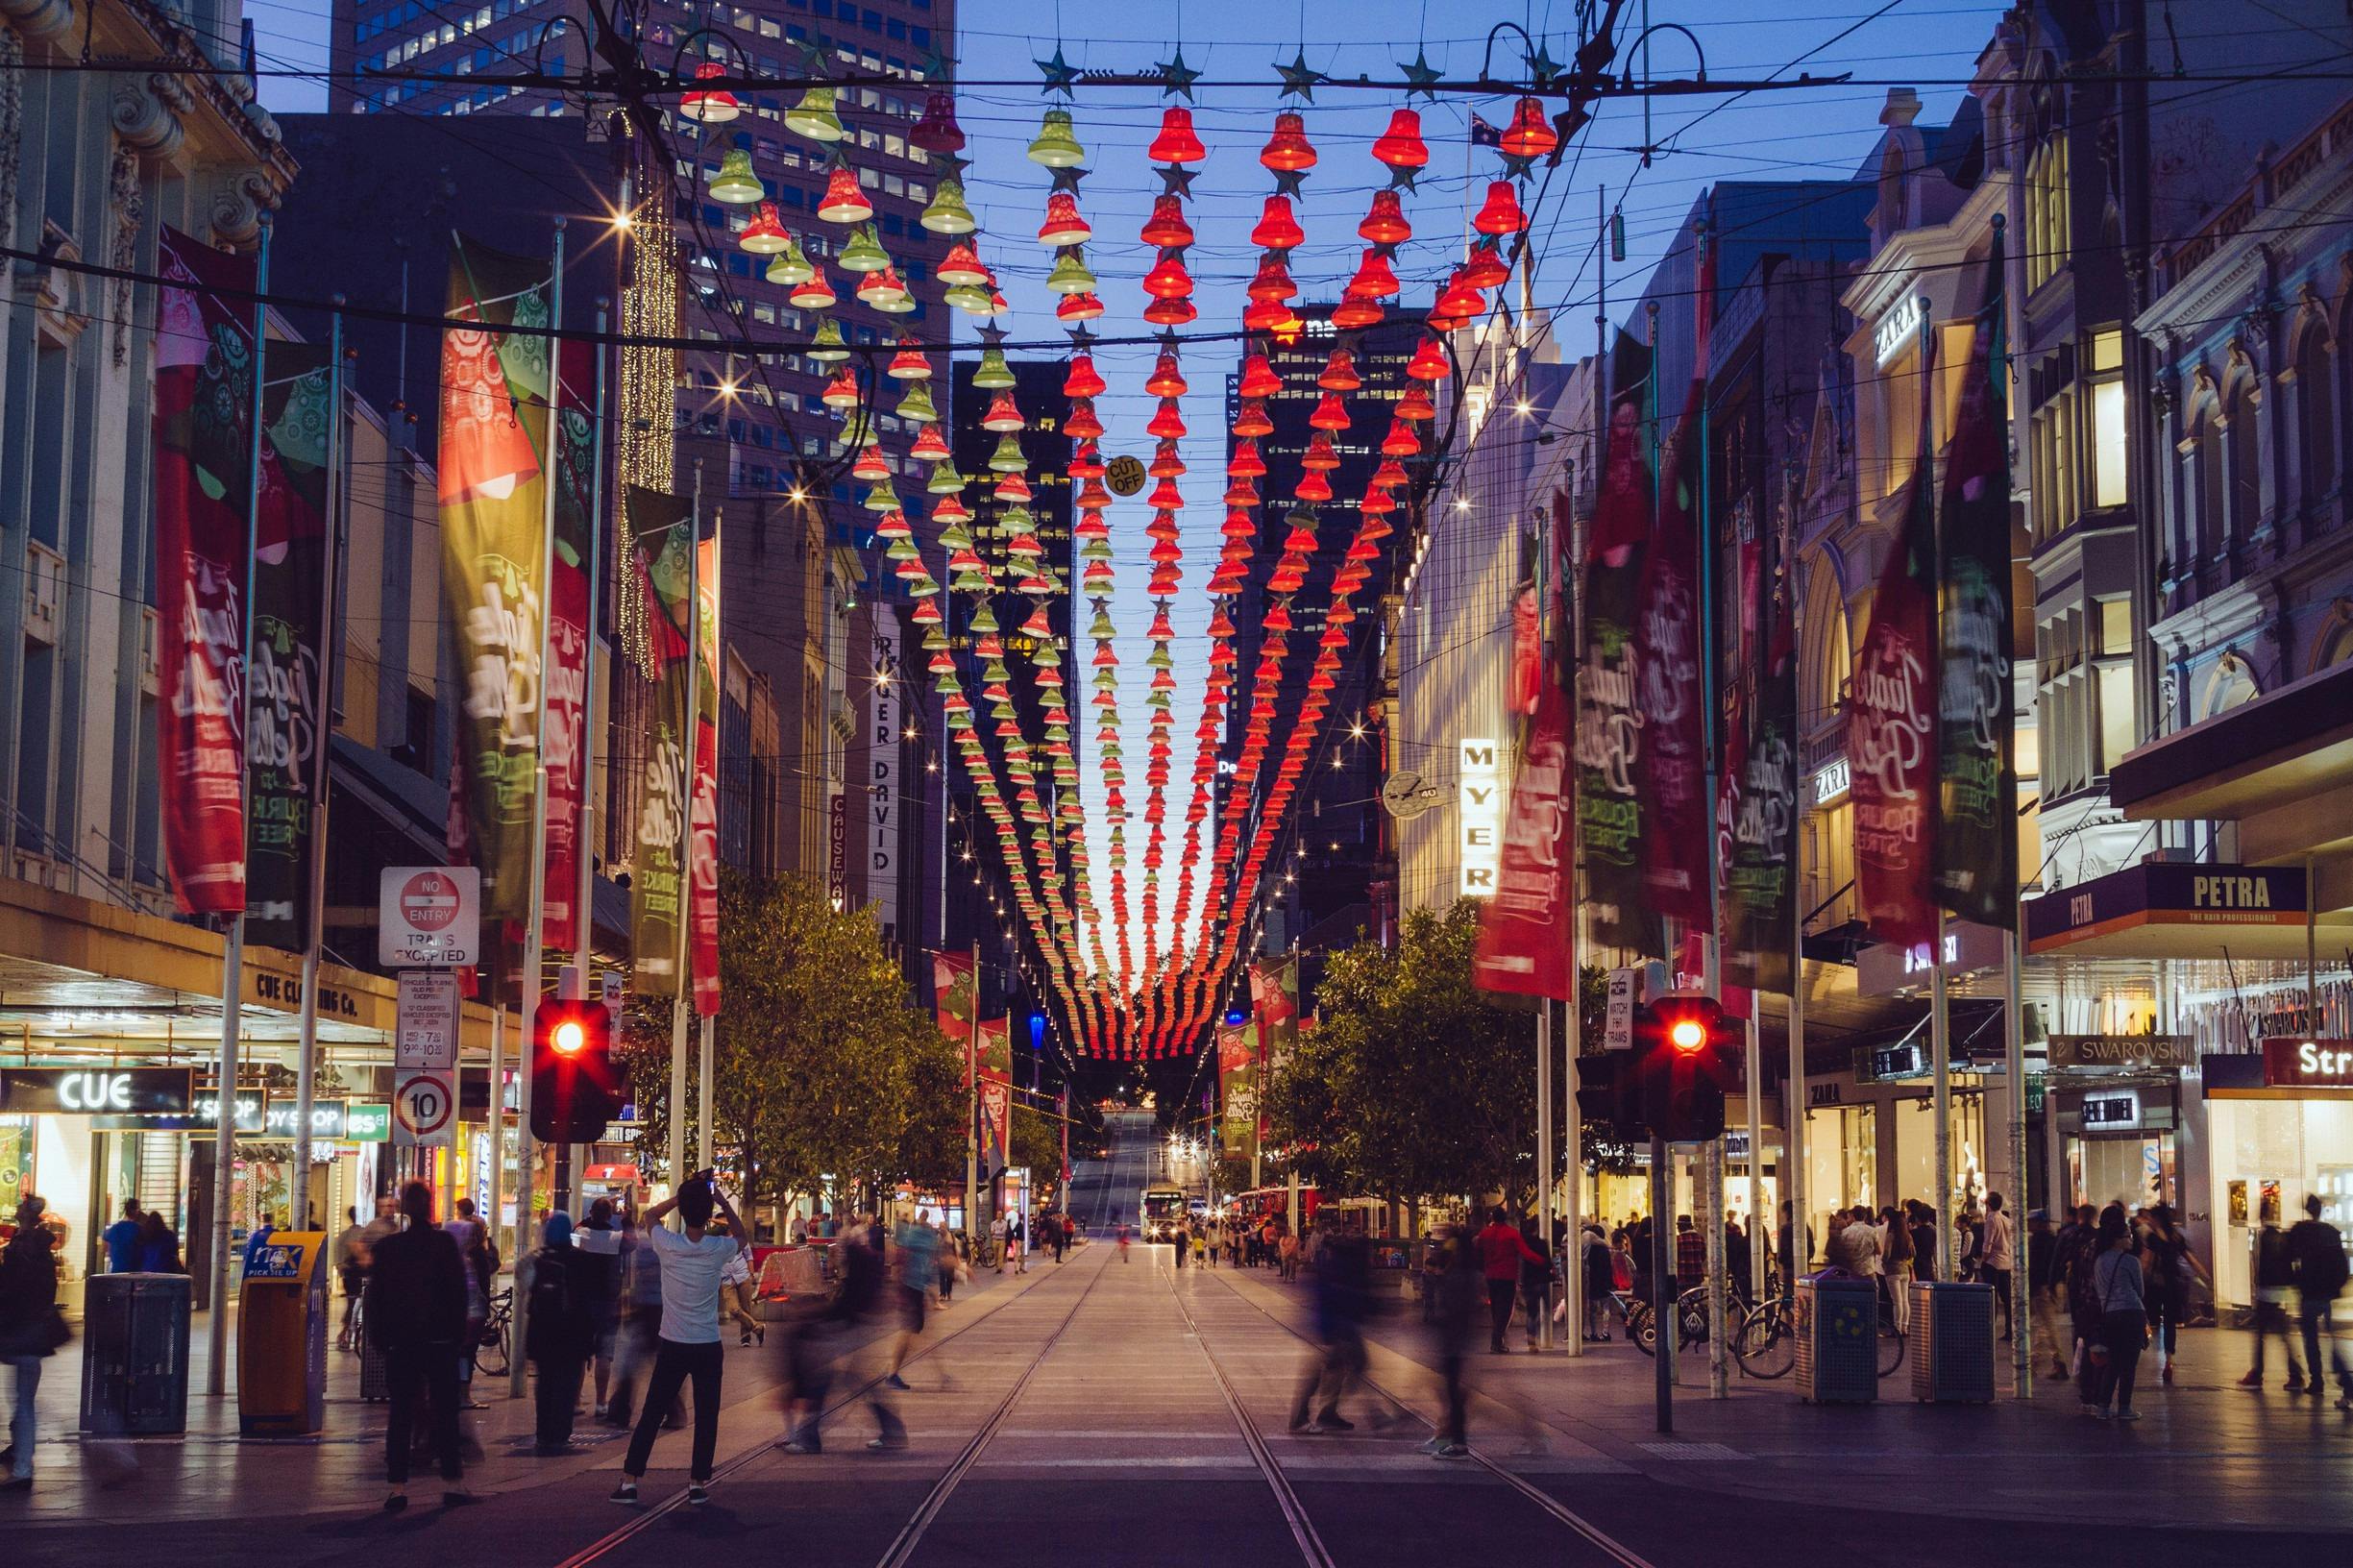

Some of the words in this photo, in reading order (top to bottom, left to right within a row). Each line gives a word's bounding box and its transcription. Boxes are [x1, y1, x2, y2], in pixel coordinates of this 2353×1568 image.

[1875, 297, 1916, 361] ZARA
[1110, 459, 1137, 478] CUT
[1115, 474, 1140, 492] OFF
[872, 636, 892, 745] ROGER
[1815, 763, 1847, 800] ZARA
[872, 761, 891, 870] DAVID
[1464, 747, 1494, 887] MYER
[831, 798, 845, 913] CAUSEWAY
[423, 881, 440, 893] NO
[2194, 875, 2271, 908] PETRA
[409, 909, 452, 921] ENTRY
[2071, 893, 2093, 927] PETRA
[2190, 913, 2202, 922] THE
[2204, 914, 2219, 922] HAIR
[2222, 914, 2276, 922] PROFESSIONALS
[407, 934, 455, 946] TRAMS
[395, 949, 465, 962] EXCEPTED
[257, 973, 281, 1000] CUE
[283, 979, 339, 1013] CLING
[341, 992, 358, 1017] Co.
[2082, 1042, 2190, 1059] SWAROVSKI
[60, 1073, 132, 1108] CUE
[410, 1092, 438, 1118] 10
[289, 1112, 339, 1127] SOP
